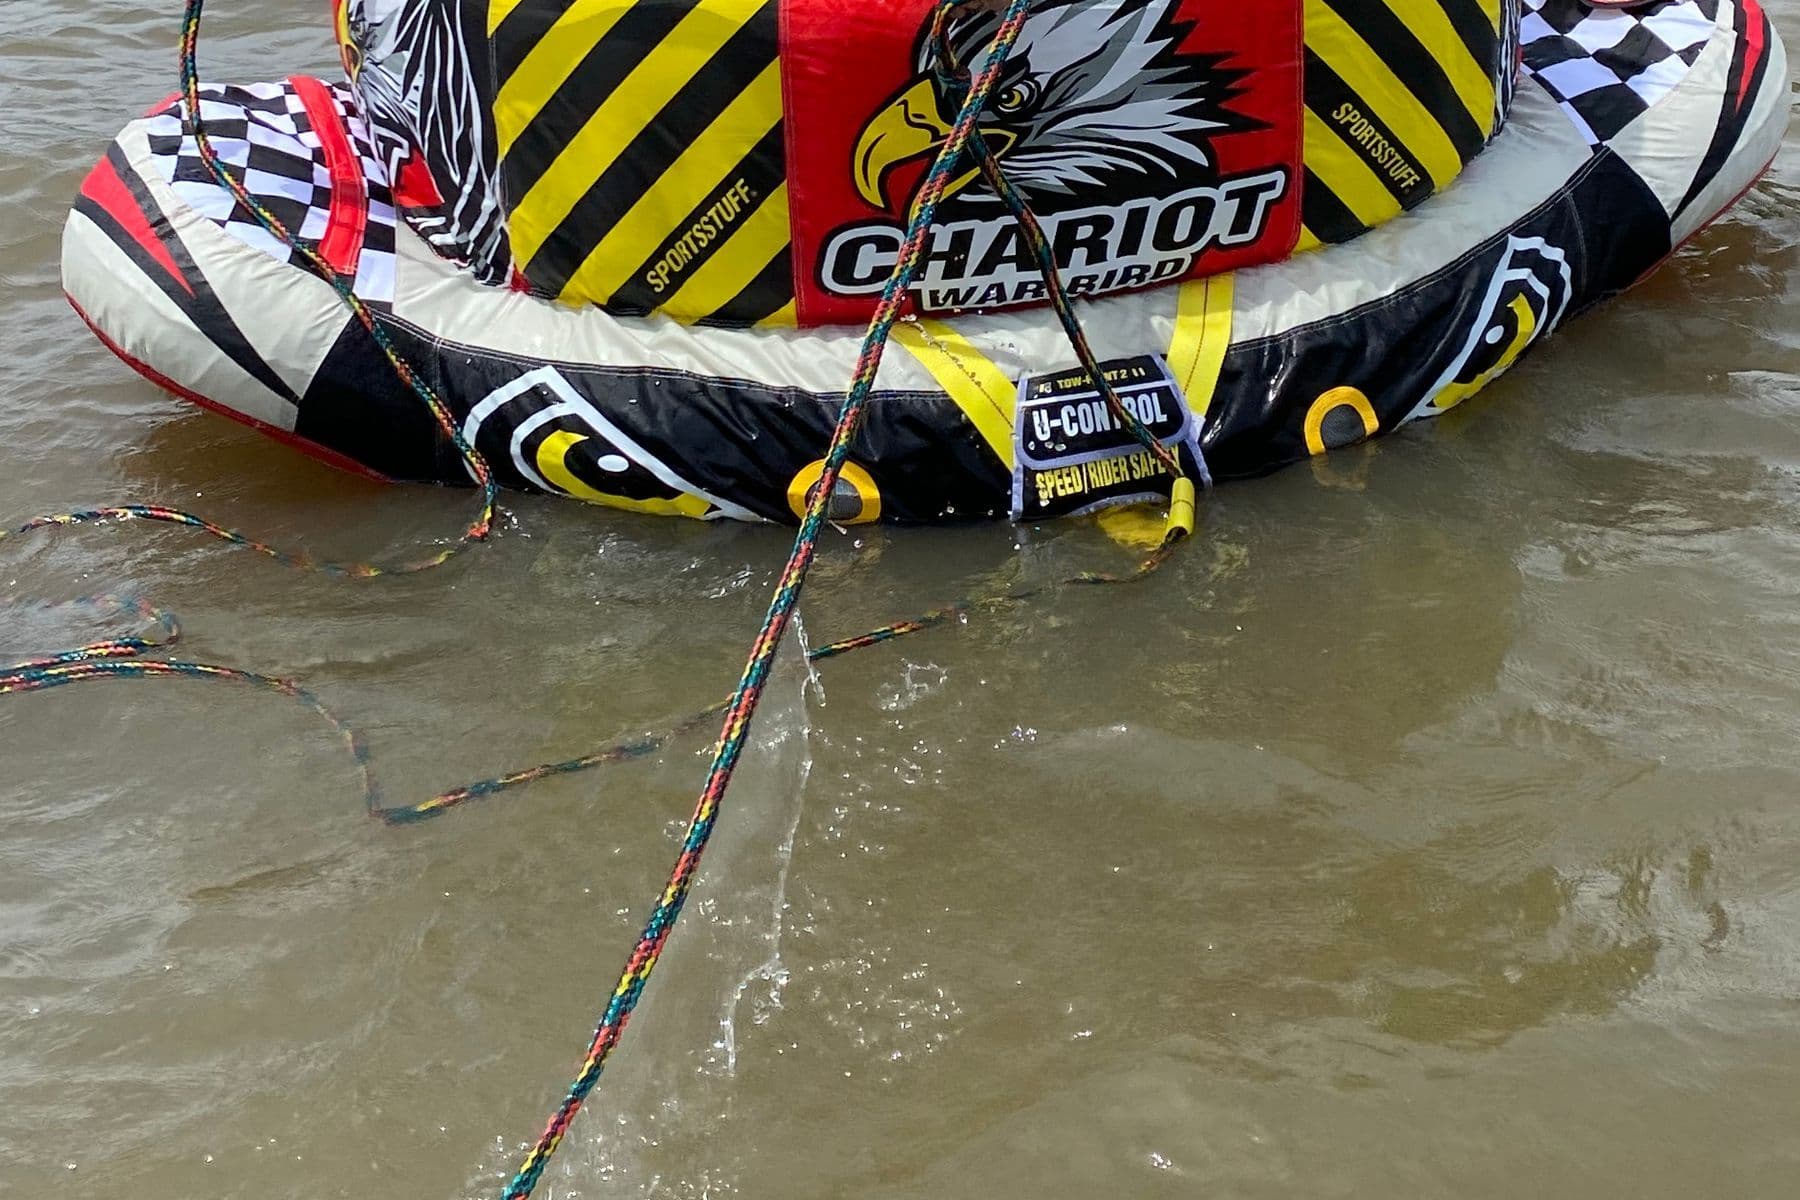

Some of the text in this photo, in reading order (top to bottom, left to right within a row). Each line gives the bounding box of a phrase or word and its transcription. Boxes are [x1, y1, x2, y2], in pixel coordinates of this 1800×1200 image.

[1332, 102, 1420, 189] SPORTSSTUFF
[646, 178, 750, 292] SPORTSSTUFF
[829, 180, 1279, 286] CHARIOT
[928, 258, 1185, 308] WAR BIRD
[1032, 392, 1168, 442] U-CONROL
[1035, 454, 1130, 499] SPEED/RIDER
